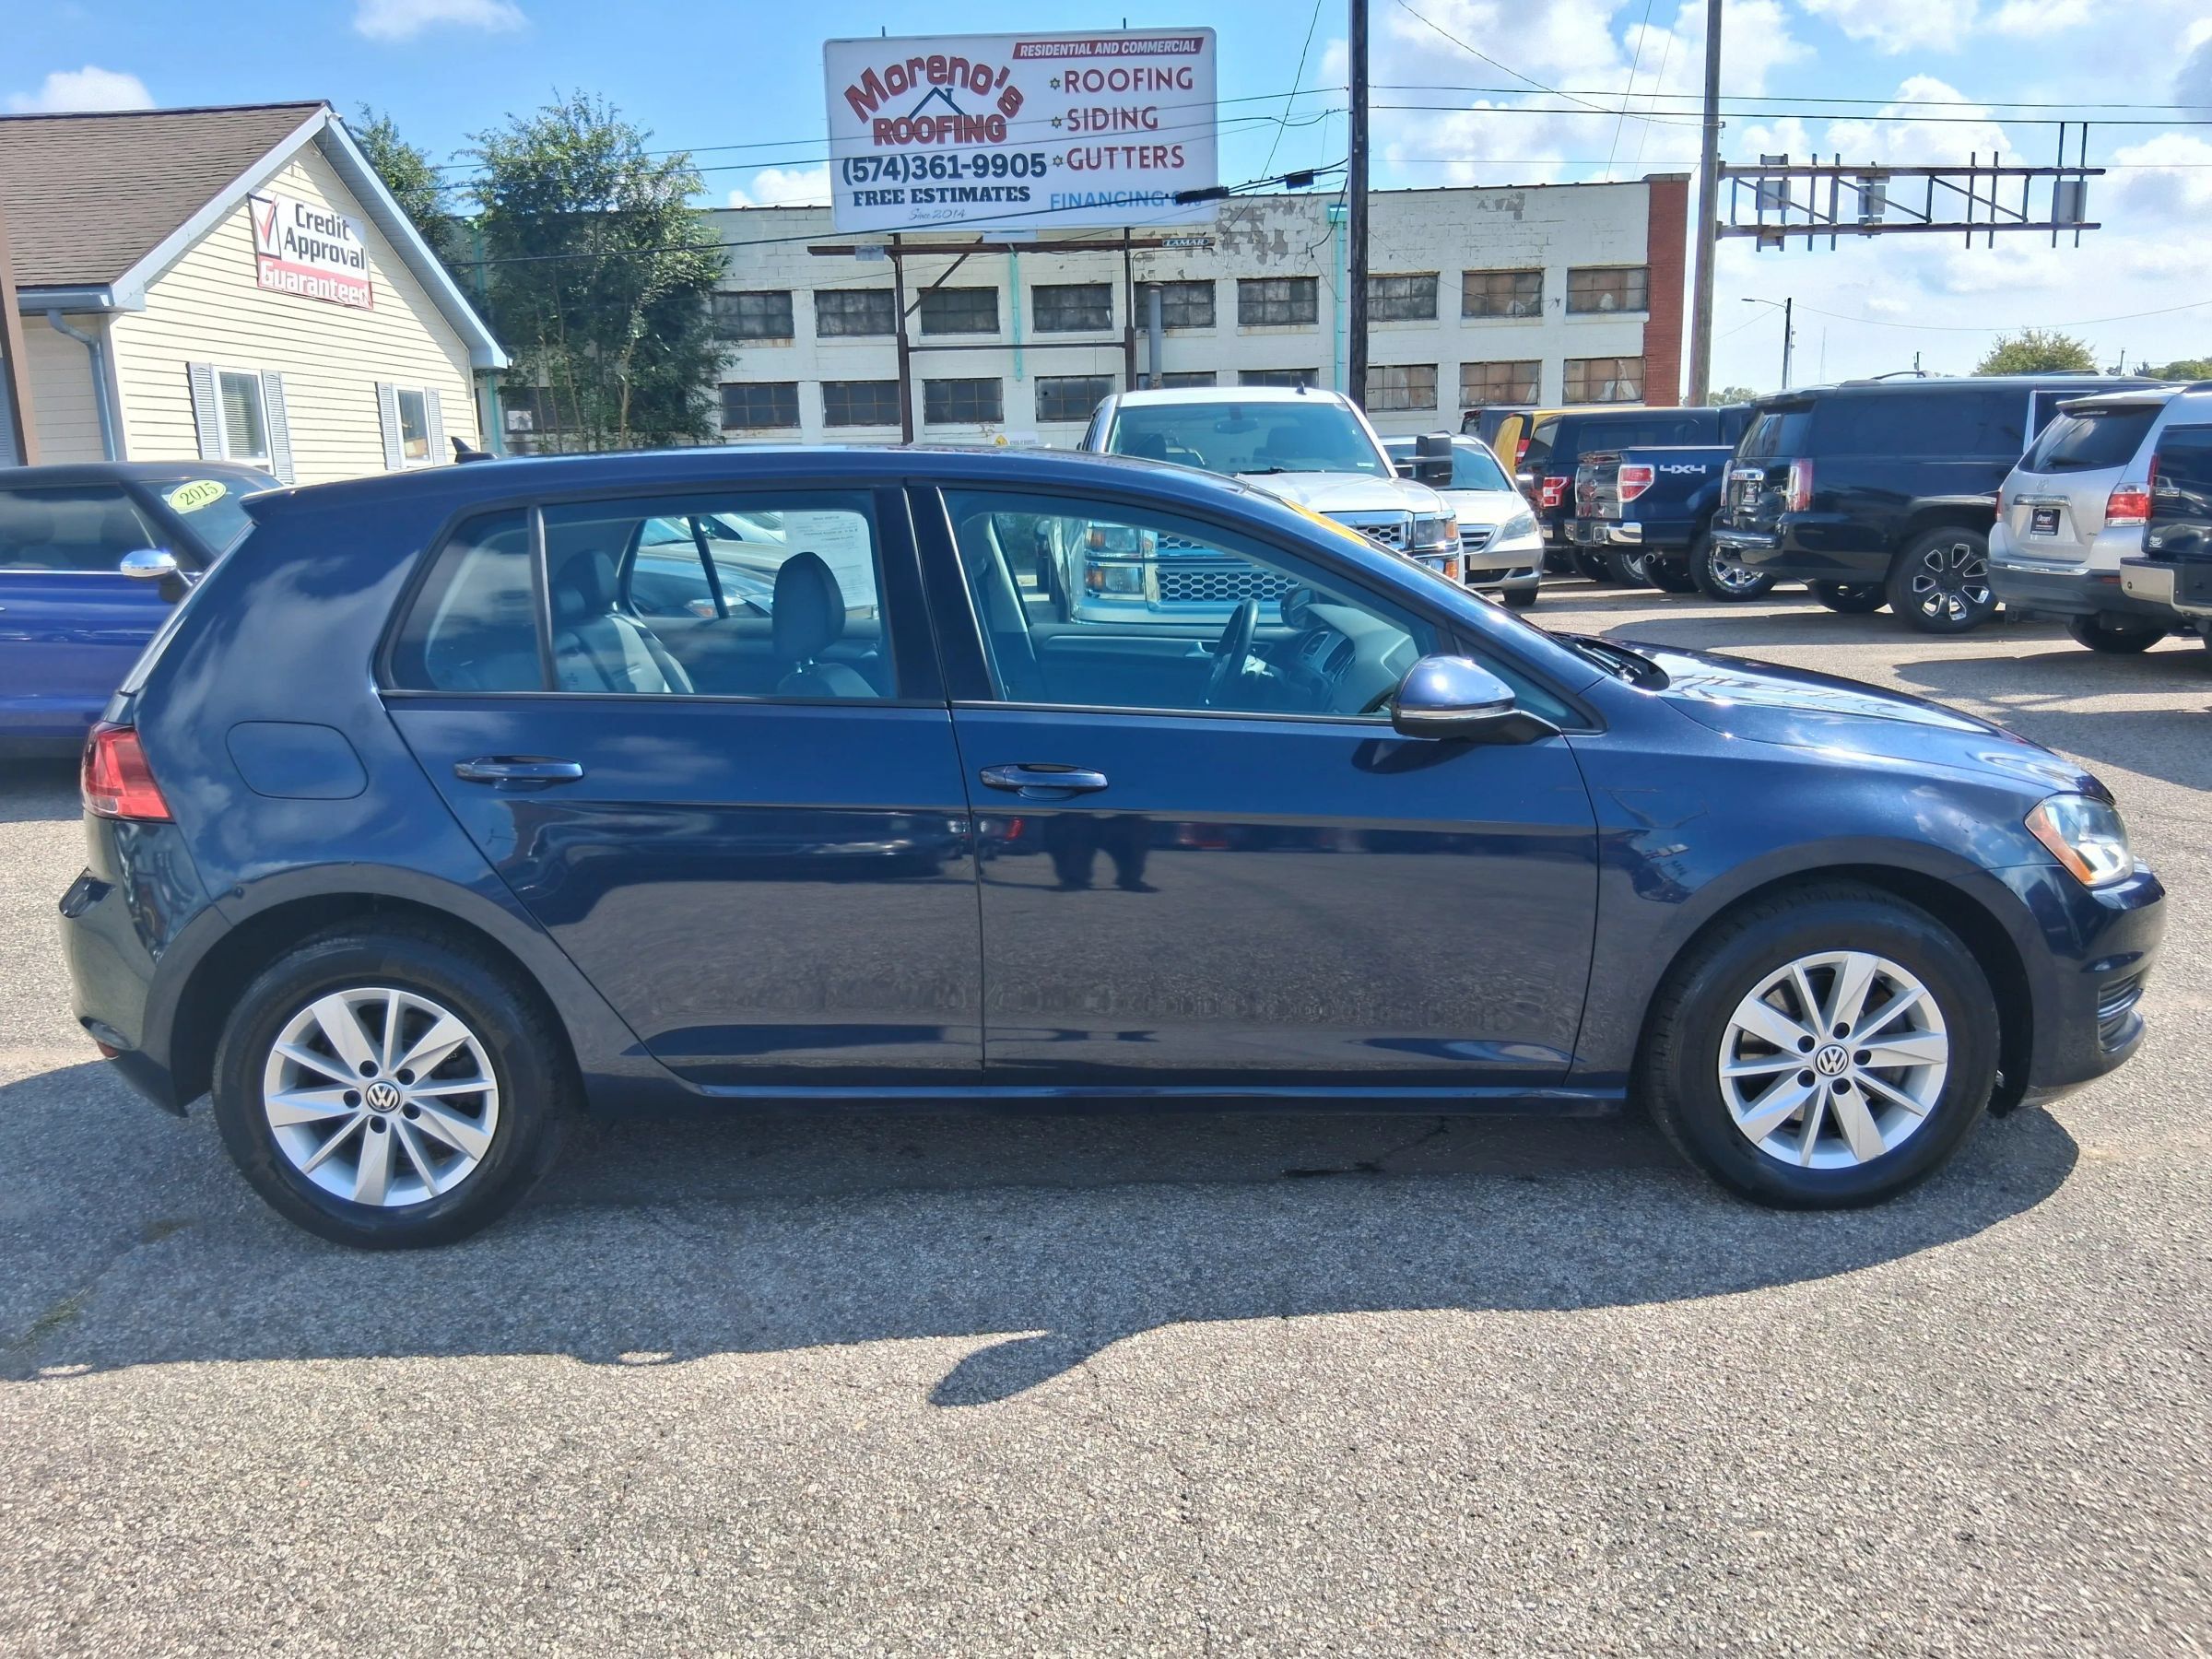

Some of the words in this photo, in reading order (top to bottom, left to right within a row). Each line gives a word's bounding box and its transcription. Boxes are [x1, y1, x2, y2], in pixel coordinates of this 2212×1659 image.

[1020, 44, 1091, 57] RESIDENTIAL
[1095, 42, 1118, 54] AND
[1122, 40, 1196, 53] COMMERCIAL
[844, 55, 1024, 124] Moreno's
[1065, 67, 1194, 93] ROOFING
[873, 114, 1007, 146] ROOFING
[1067, 106, 1159, 132] SIDING
[842, 153, 1047, 185] (574)361-9905
[1066, 146, 1185, 171] GUTTERS
[853, 188, 905, 206] FREE
[911, 186, 1030, 203] ESTIMATES
[1051, 190, 1165, 210] FINANCING
[295, 203, 350, 241] Credit
[932, 208, 966, 219] 2014
[284, 226, 366, 270] Approval
[260, 260, 369, 305] Guaranteed
[179, 482, 218, 506] 2015
